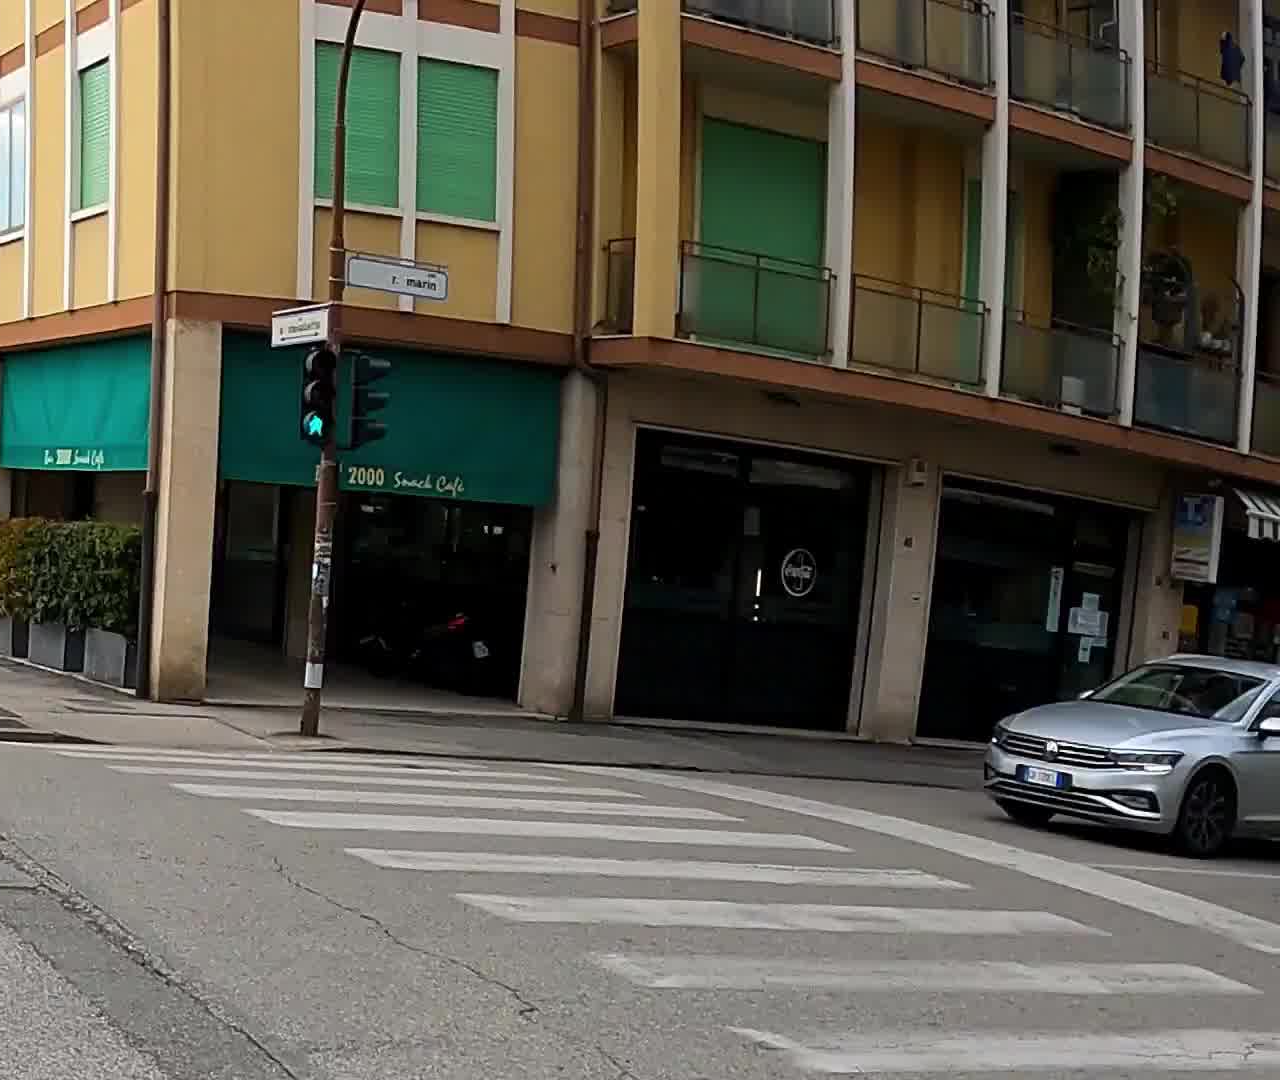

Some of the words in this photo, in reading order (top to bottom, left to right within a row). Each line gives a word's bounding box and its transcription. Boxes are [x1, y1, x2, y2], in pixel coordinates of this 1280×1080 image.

[406, 278, 437, 291] marin
[349, 466, 385, 486] 2000
[394, 472, 432, 489] Snack
